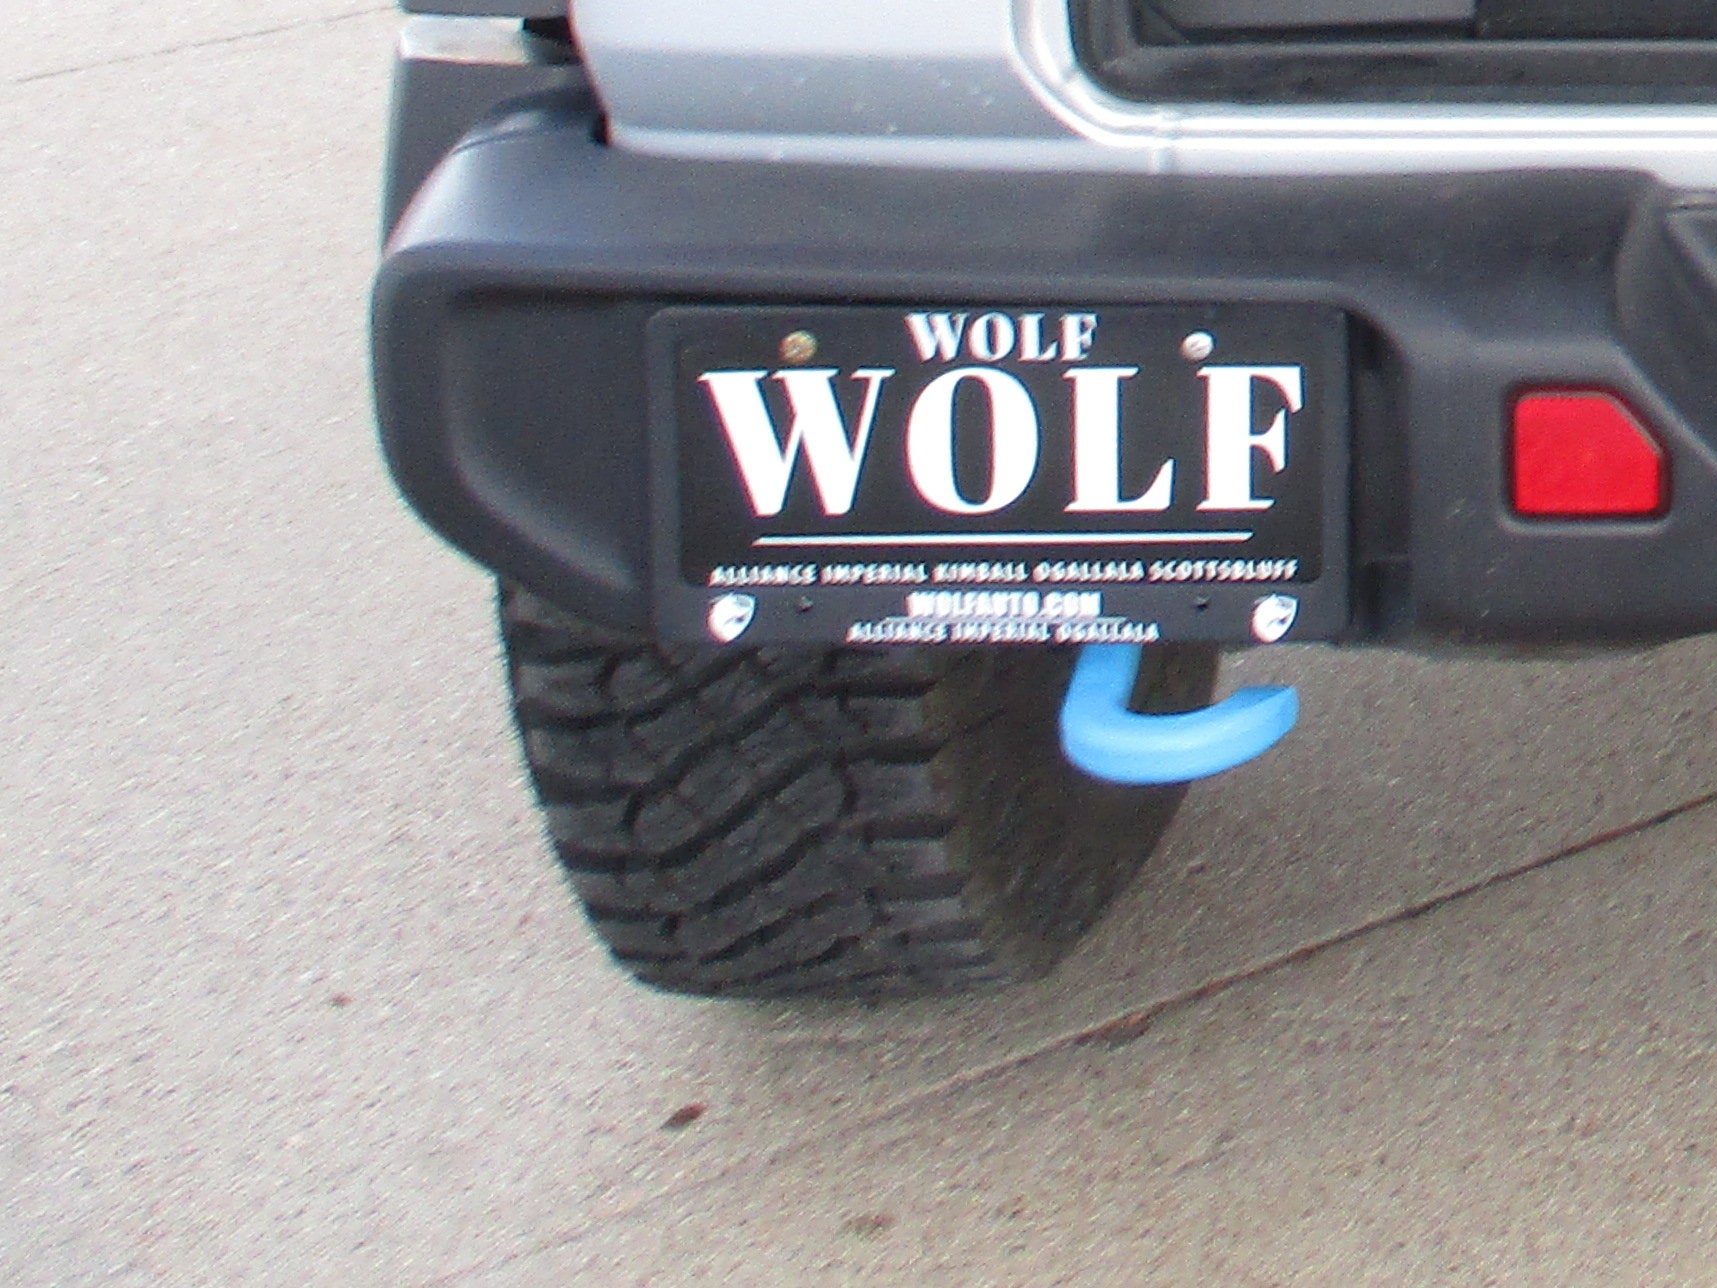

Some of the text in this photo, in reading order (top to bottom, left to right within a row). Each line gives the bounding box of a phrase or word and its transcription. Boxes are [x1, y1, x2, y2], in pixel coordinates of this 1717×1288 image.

[904, 312, 1098, 362] WOLF
[698, 366, 1302, 516] WOLF
[708, 564, 818, 587] ALLIANCE
[820, 562, 928, 585] IMPERIAL
[930, 561, 1029, 584] KIMBALL
[1149, 558, 1299, 582] SCOTTSBLUFF
[845, 620, 949, 643] ALLIANCE
[950, 620, 1051, 643] IMPERIAL
